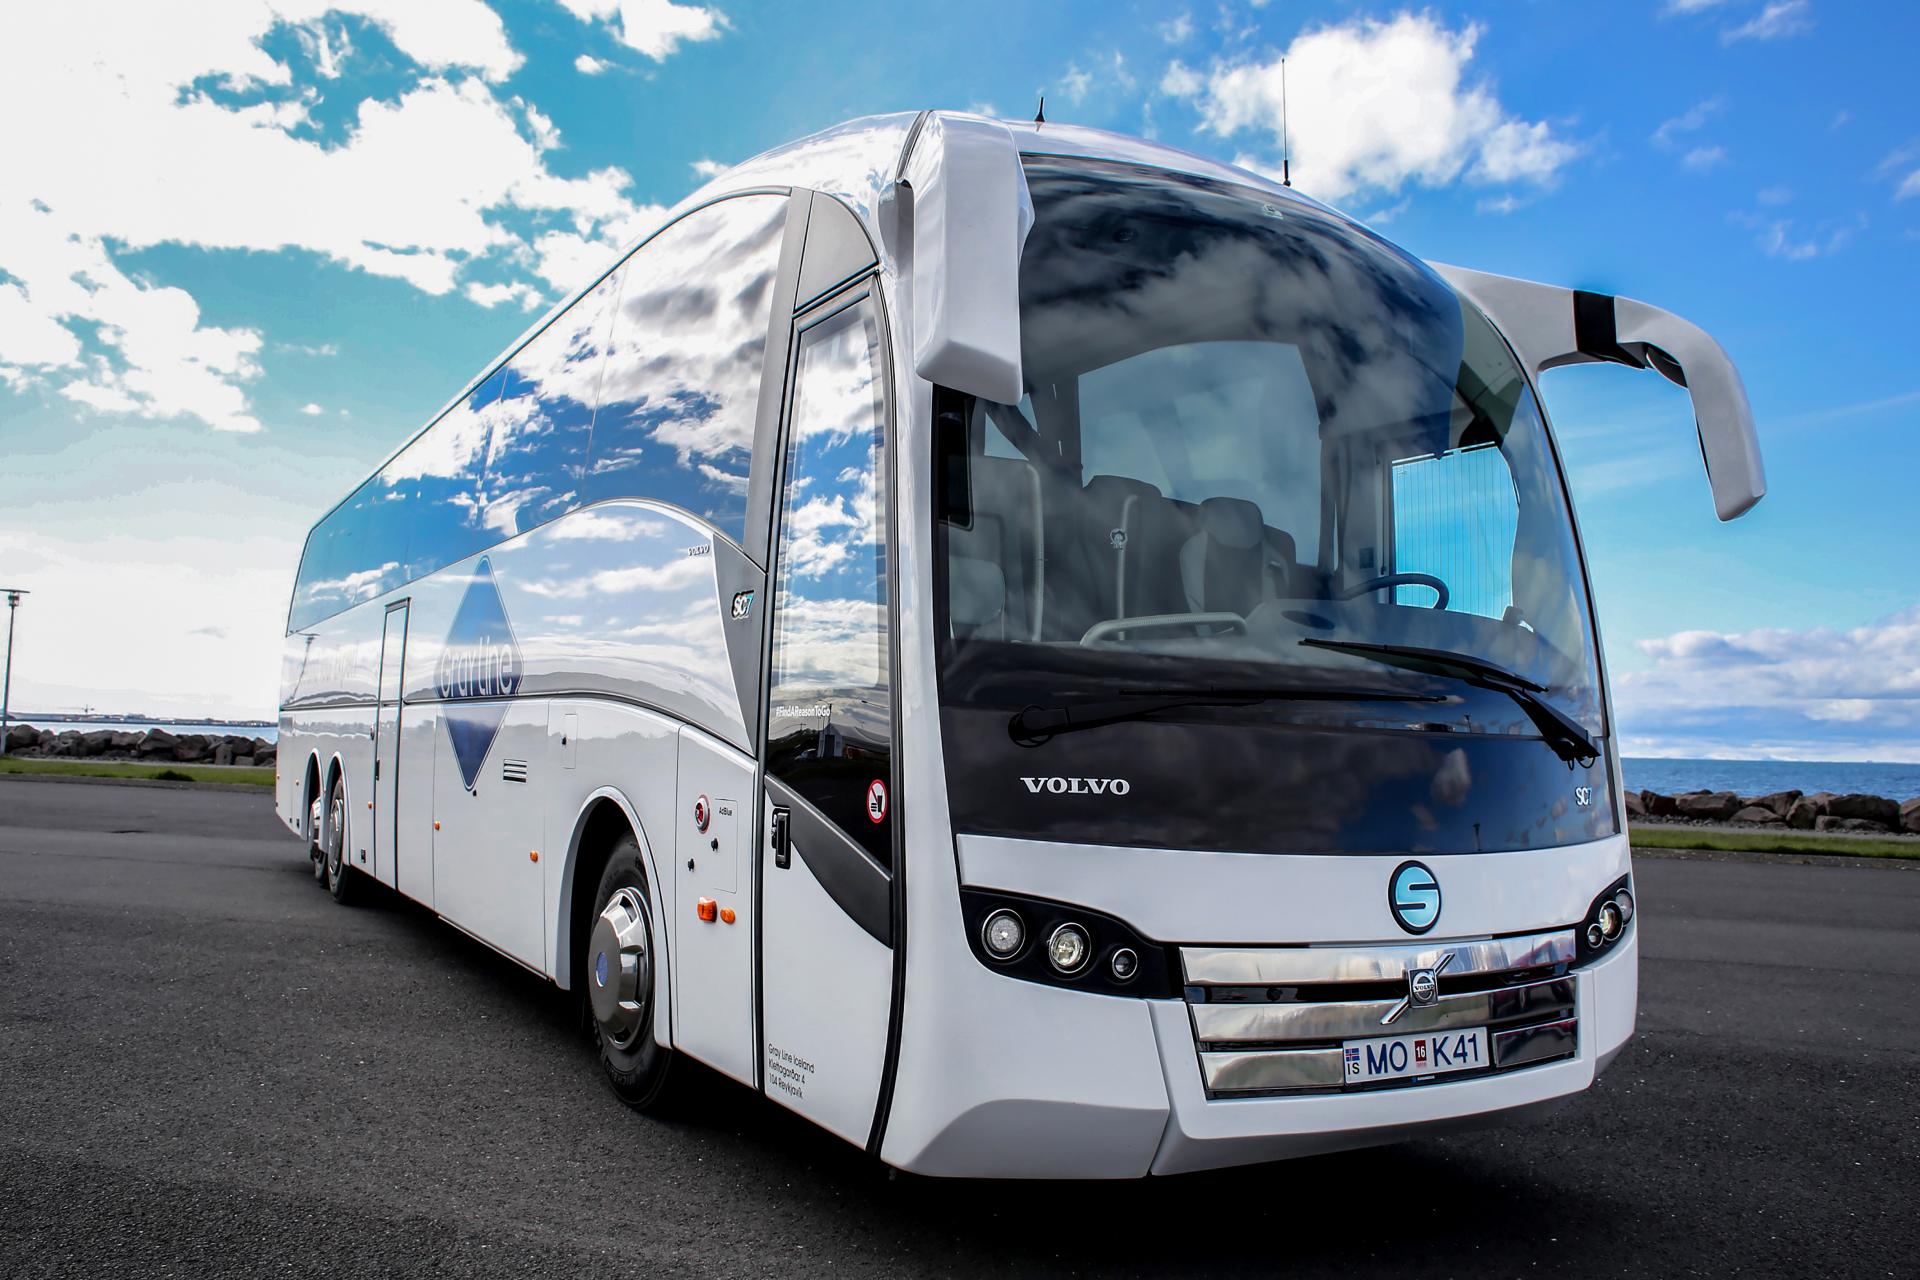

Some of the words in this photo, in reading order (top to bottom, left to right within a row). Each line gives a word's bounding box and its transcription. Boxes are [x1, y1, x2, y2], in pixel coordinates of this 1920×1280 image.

[731, 590, 754, 617] SC7
[775, 705, 831, 718] #FindAReasonToGo
[1020, 777, 1130, 796] VOLVO
[1575, 787, 1593, 806] SC7
[718, 806, 733, 817] AdBlue
[1413, 983, 1435, 992] VOLVO
[1366, 1041, 1408, 1075] MO
[1432, 1033, 1479, 1067] K41
[1416, 1045, 1426, 1058] 16
[768, 1043, 781, 1060] Gray
[781, 1049, 793, 1063] Line
[793, 1055, 815, 1074] Iceland
[1347, 1062, 1360, 1075] IS
[769, 1073, 778, 1085] 104
[801, 1074, 806, 1085] 4
